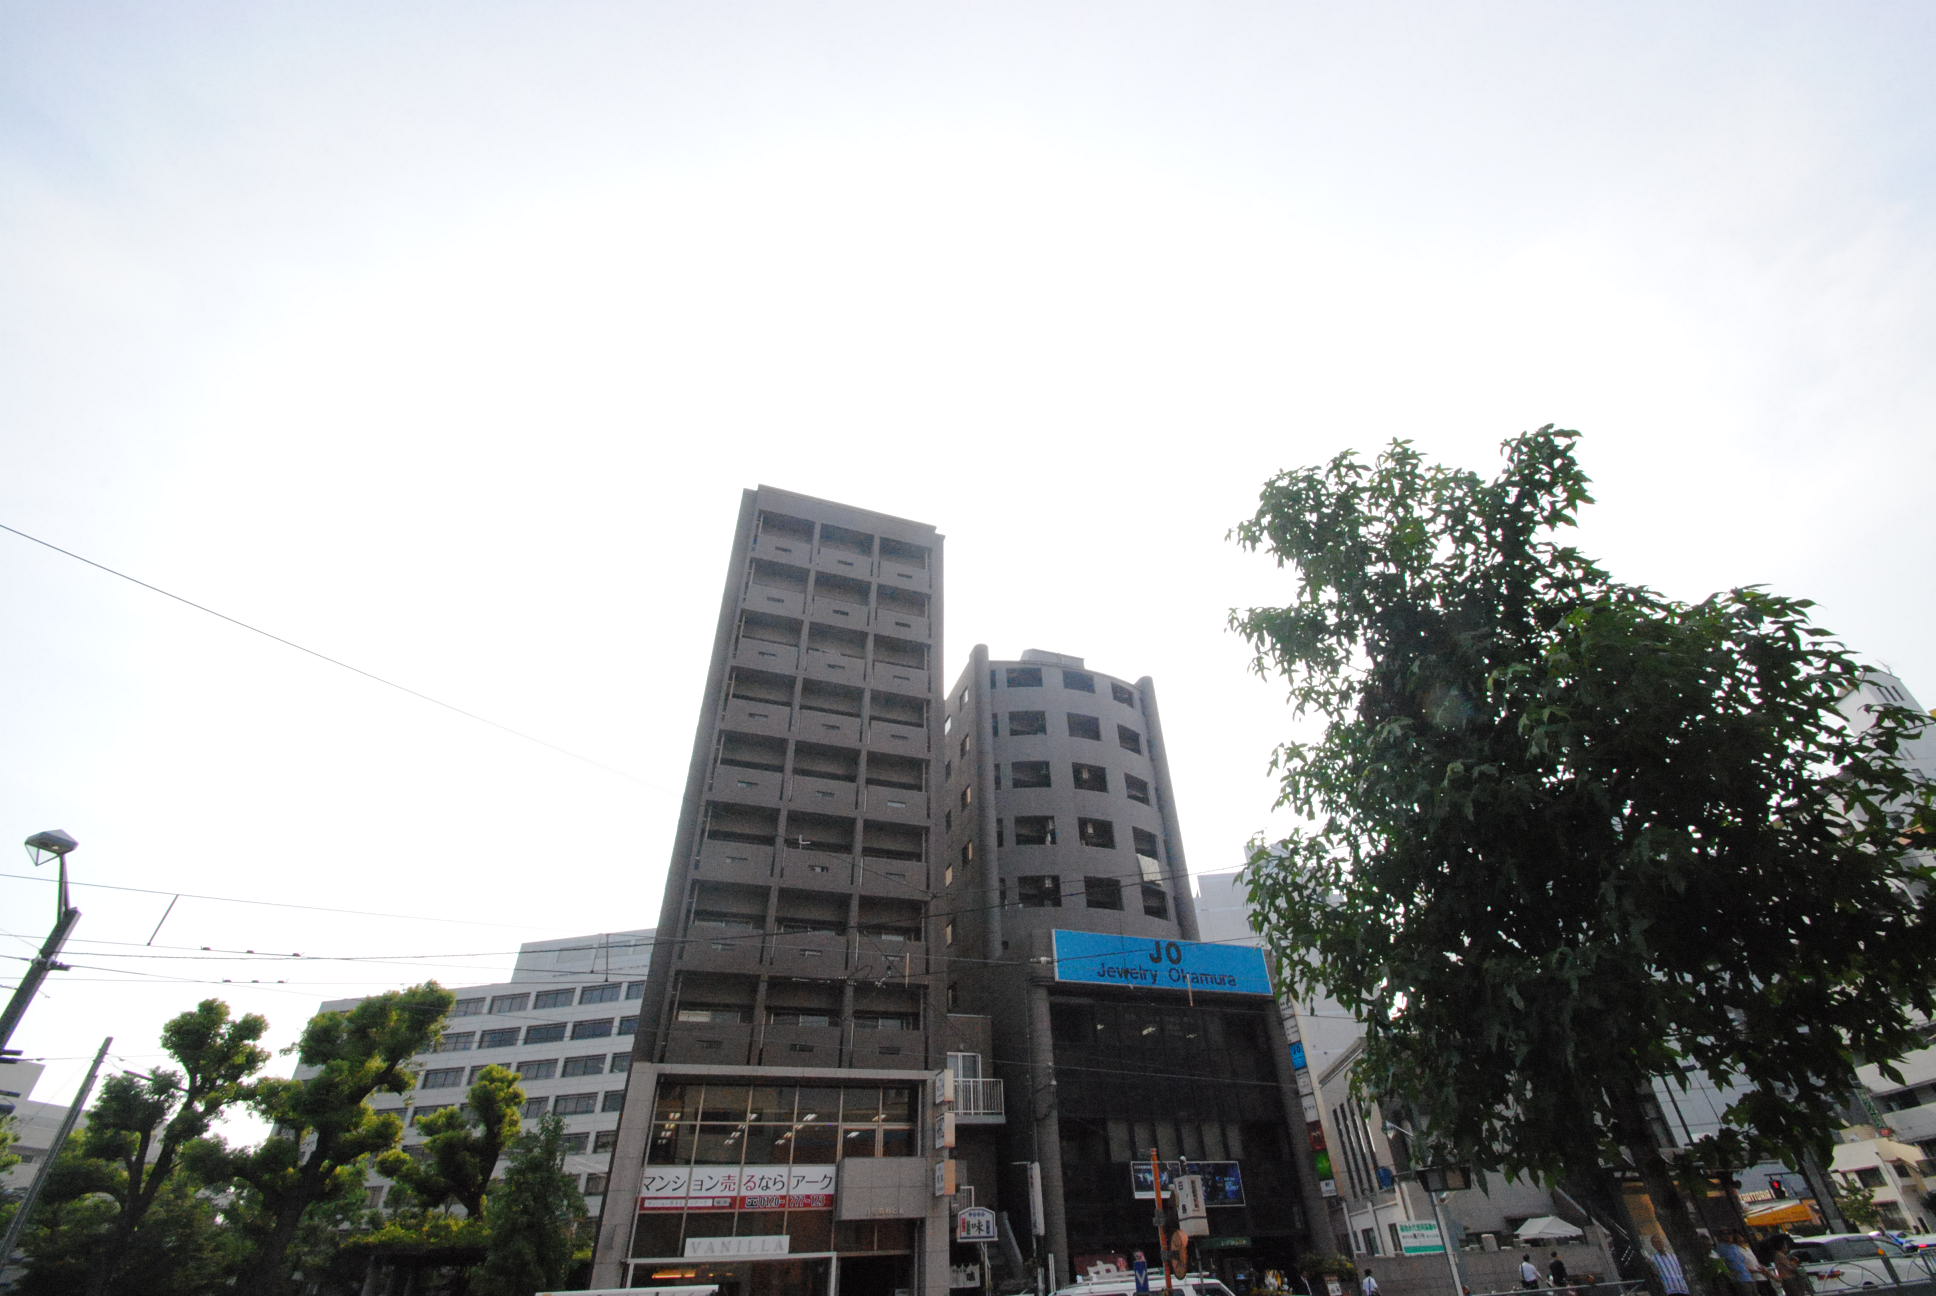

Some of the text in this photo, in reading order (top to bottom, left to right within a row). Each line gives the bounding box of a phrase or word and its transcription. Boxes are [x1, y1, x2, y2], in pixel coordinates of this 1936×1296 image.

[1149, 940, 1182, 964] JO
[1097, 962, 1158, 984] Jewelry
[690, 1237, 785, 1255] VANILLA
